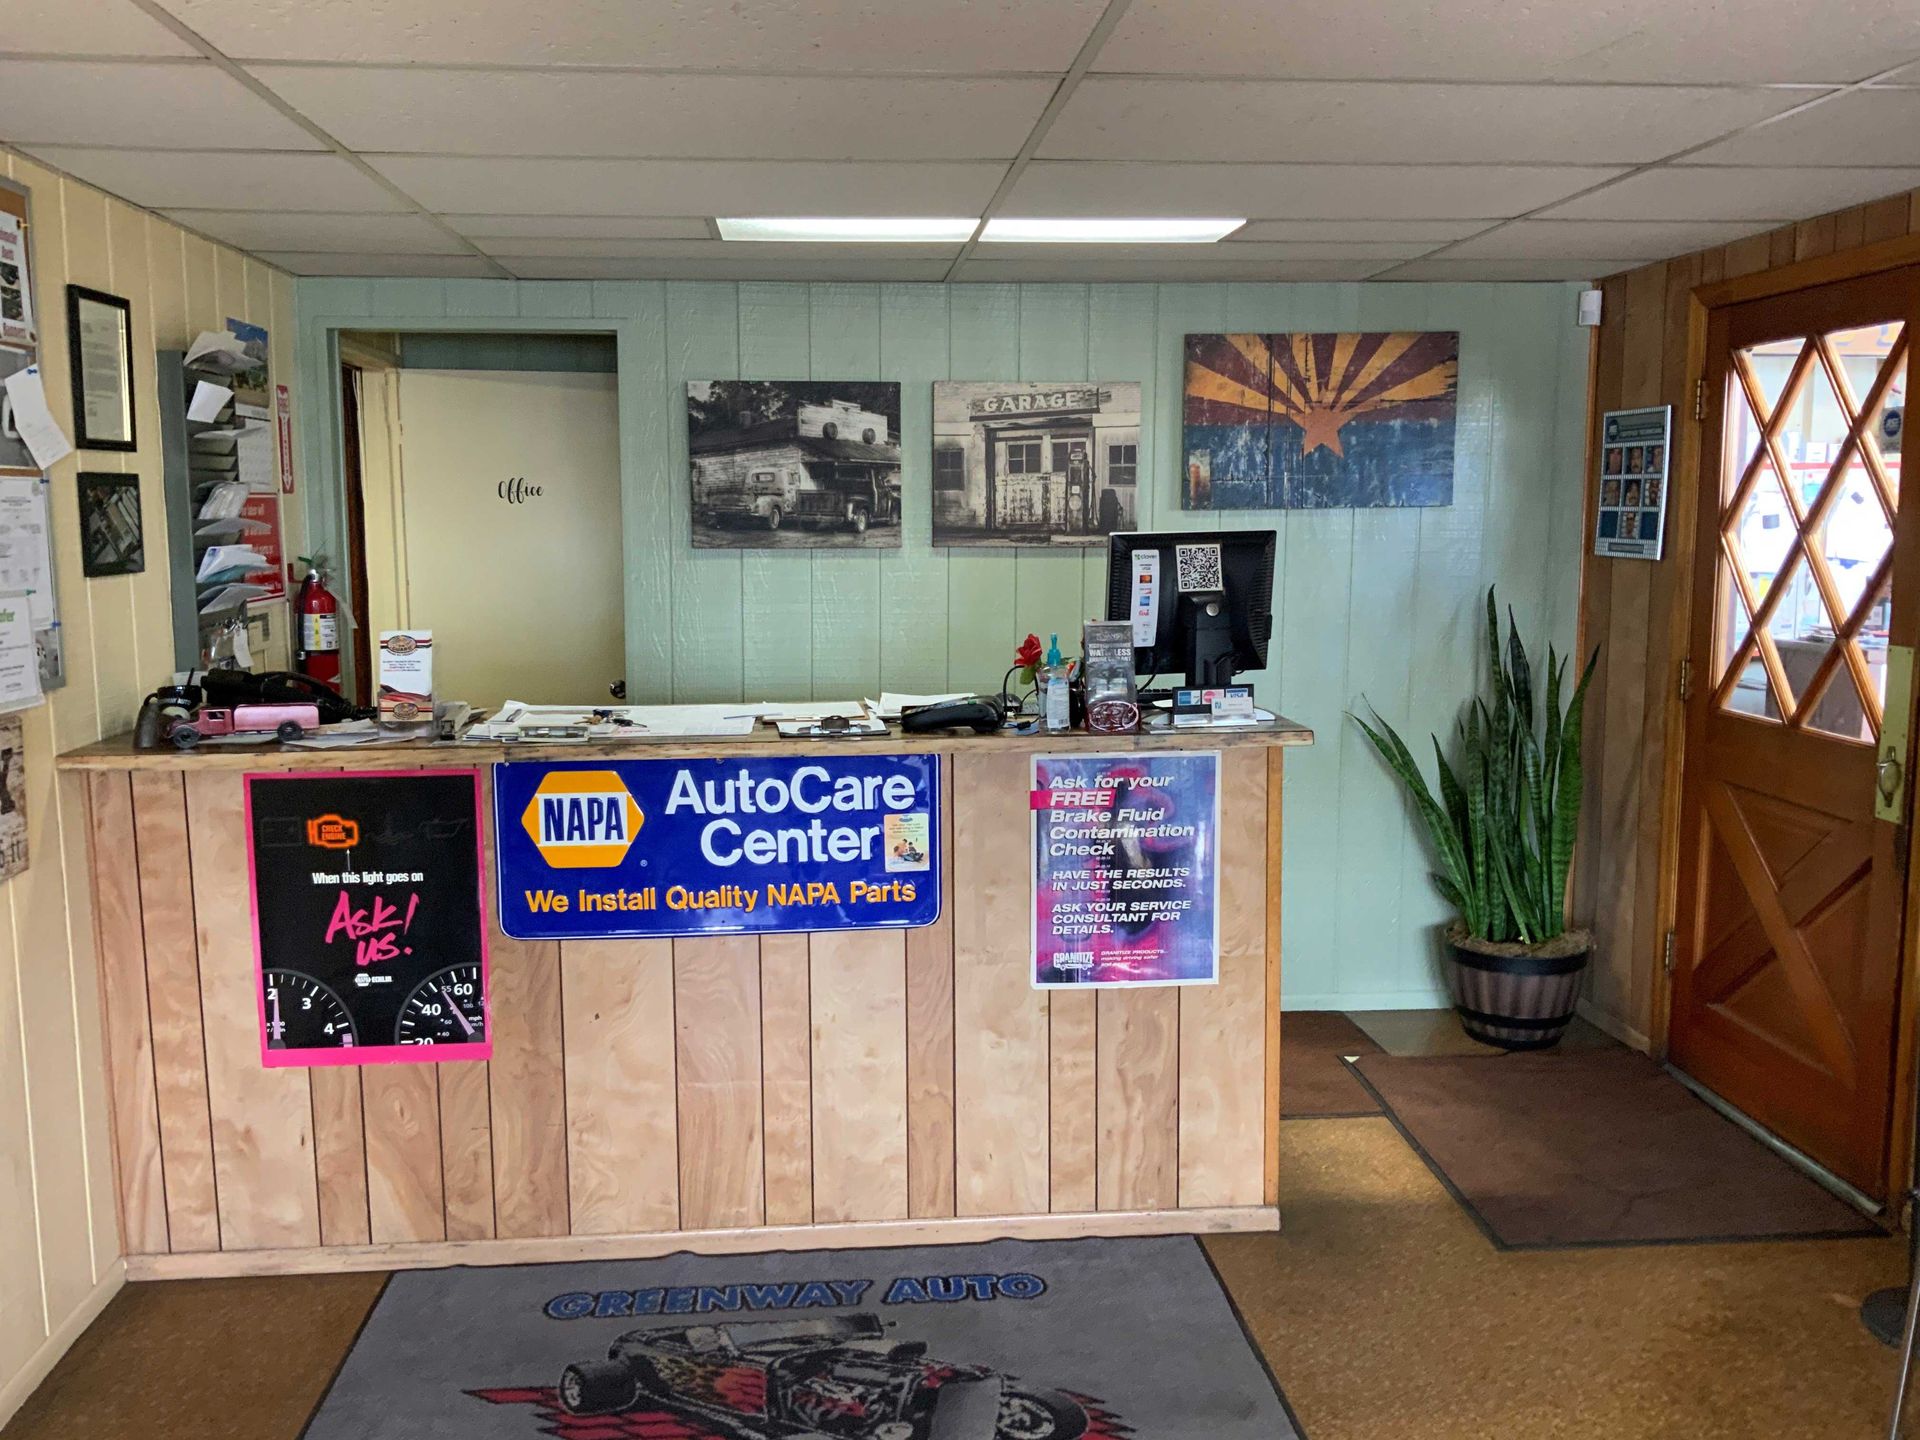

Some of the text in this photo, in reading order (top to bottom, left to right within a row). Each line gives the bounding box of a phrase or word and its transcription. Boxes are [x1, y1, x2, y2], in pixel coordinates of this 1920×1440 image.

[984, 392, 1077, 411] GARAGE
[498, 477, 544, 504] Office
[1089, 648, 1131, 657] WATLESS
[1049, 775, 1174, 790] Ask for your
[665, 765, 916, 815] AutoCare
[1050, 790, 1112, 806] FREE
[543, 797, 625, 842] NAPA
[1050, 808, 1165, 823] Brake Fluid
[321, 832, 347, 841] ENGINE
[1050, 824, 1195, 840] Contamination
[701, 818, 880, 867] Center
[1049, 842, 1116, 857] Check
[312, 872, 424, 885] When this light goes on
[1052, 867, 1191, 880] HAVE THE RESULTS
[1052, 879, 1187, 890] IN JUST SECONDS.
[525, 880, 917, 913] We Install Quality NAPA Parts
[1051, 901, 1192, 913] ASK YOUR SERVICE
[1052, 912, 1181, 924] CONSULTANT FOR
[1052, 925, 1115, 935] DETAILS.
[267, 988, 277, 1000] 2
[453, 983, 473, 996] 60
[302, 998, 312, 1010] 3
[421, 1004, 442, 1016] 40
[324, 1023, 334, 1034] 4
[544, 1273, 1047, 1321] GREENWAY AUTO
